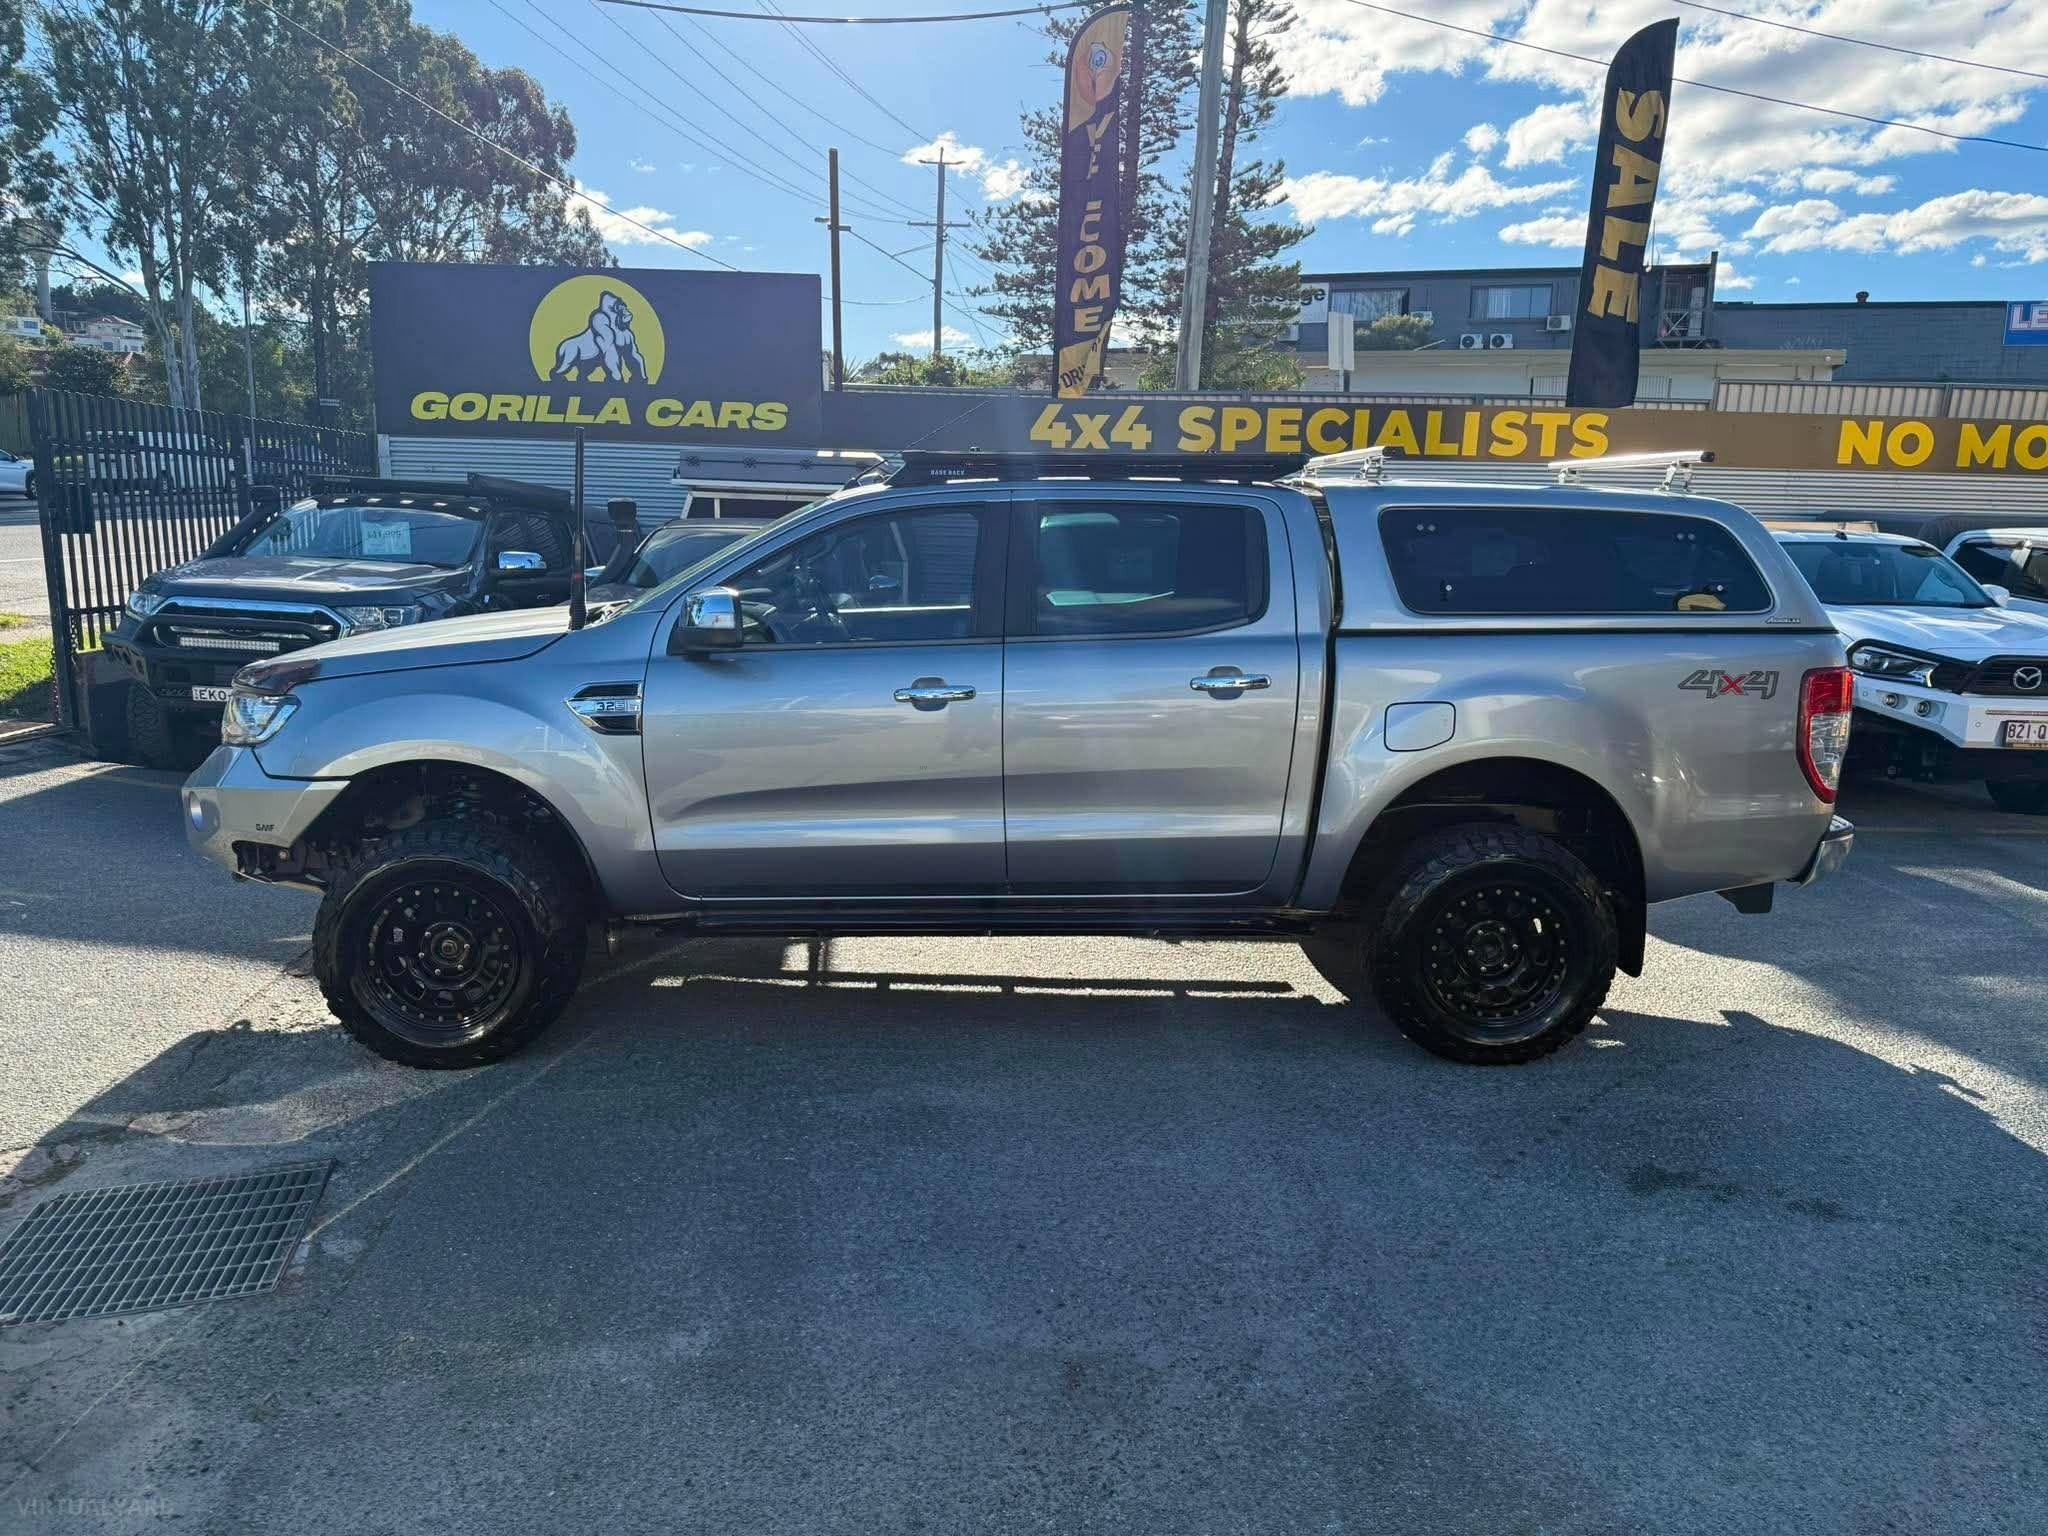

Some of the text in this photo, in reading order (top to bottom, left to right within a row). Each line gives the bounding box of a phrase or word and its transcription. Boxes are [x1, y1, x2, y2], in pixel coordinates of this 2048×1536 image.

[1587, 87, 1666, 324] SALE
[410, 391, 789, 431] GORILLA CARS
[1030, 403, 1609, 458] 4x4 SPECIALISTS
[1837, 419, 2048, 470] NO MO
